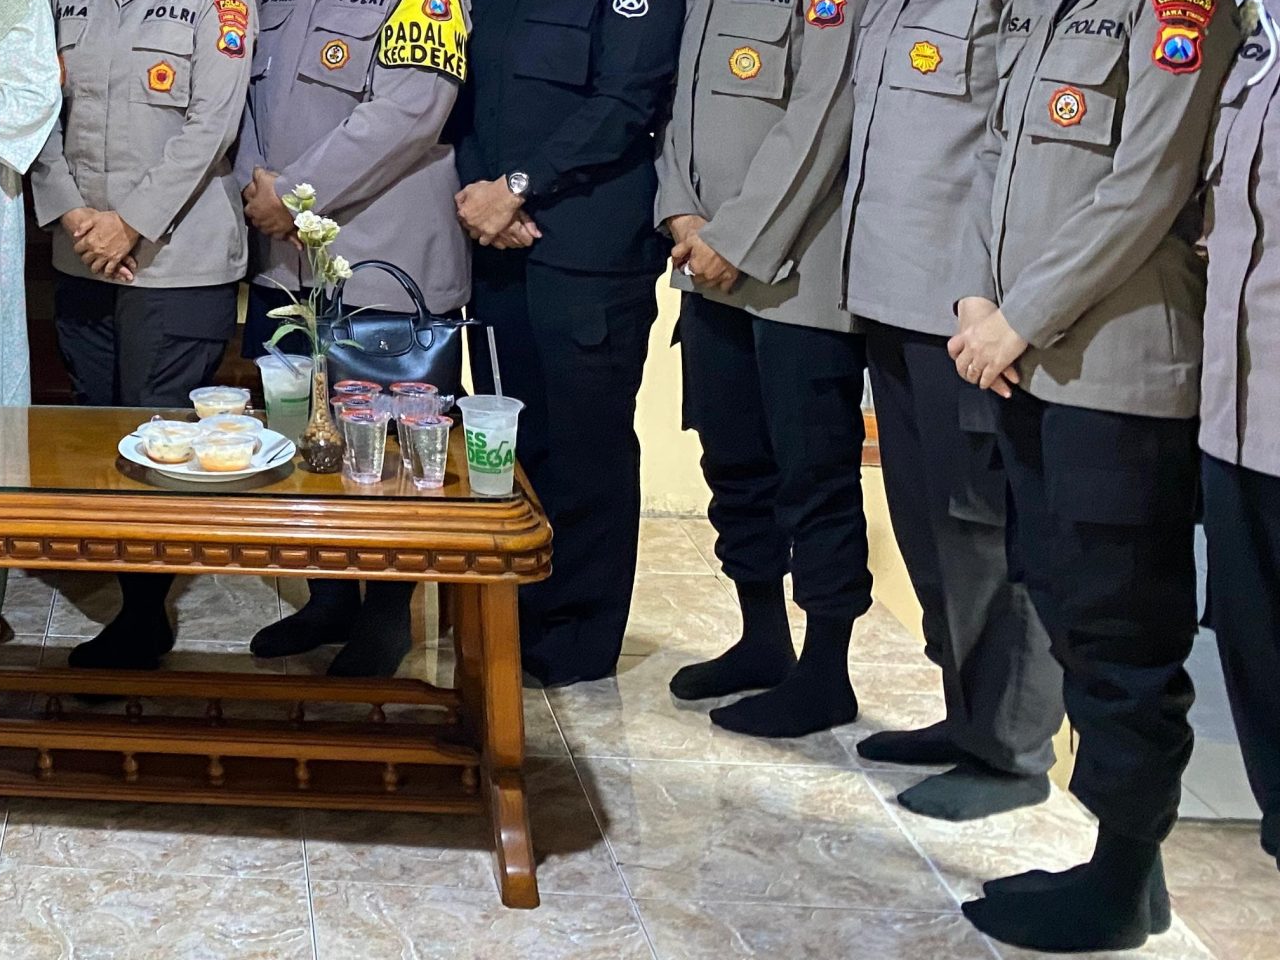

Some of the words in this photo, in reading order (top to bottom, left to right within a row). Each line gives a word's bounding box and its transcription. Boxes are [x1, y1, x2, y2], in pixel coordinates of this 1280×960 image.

[143, 5, 196, 24] POLRI
[384, 21, 446, 48] PADAL
[1064, 19, 1125, 39] POLRI
[466, 428, 488, 449] ES
